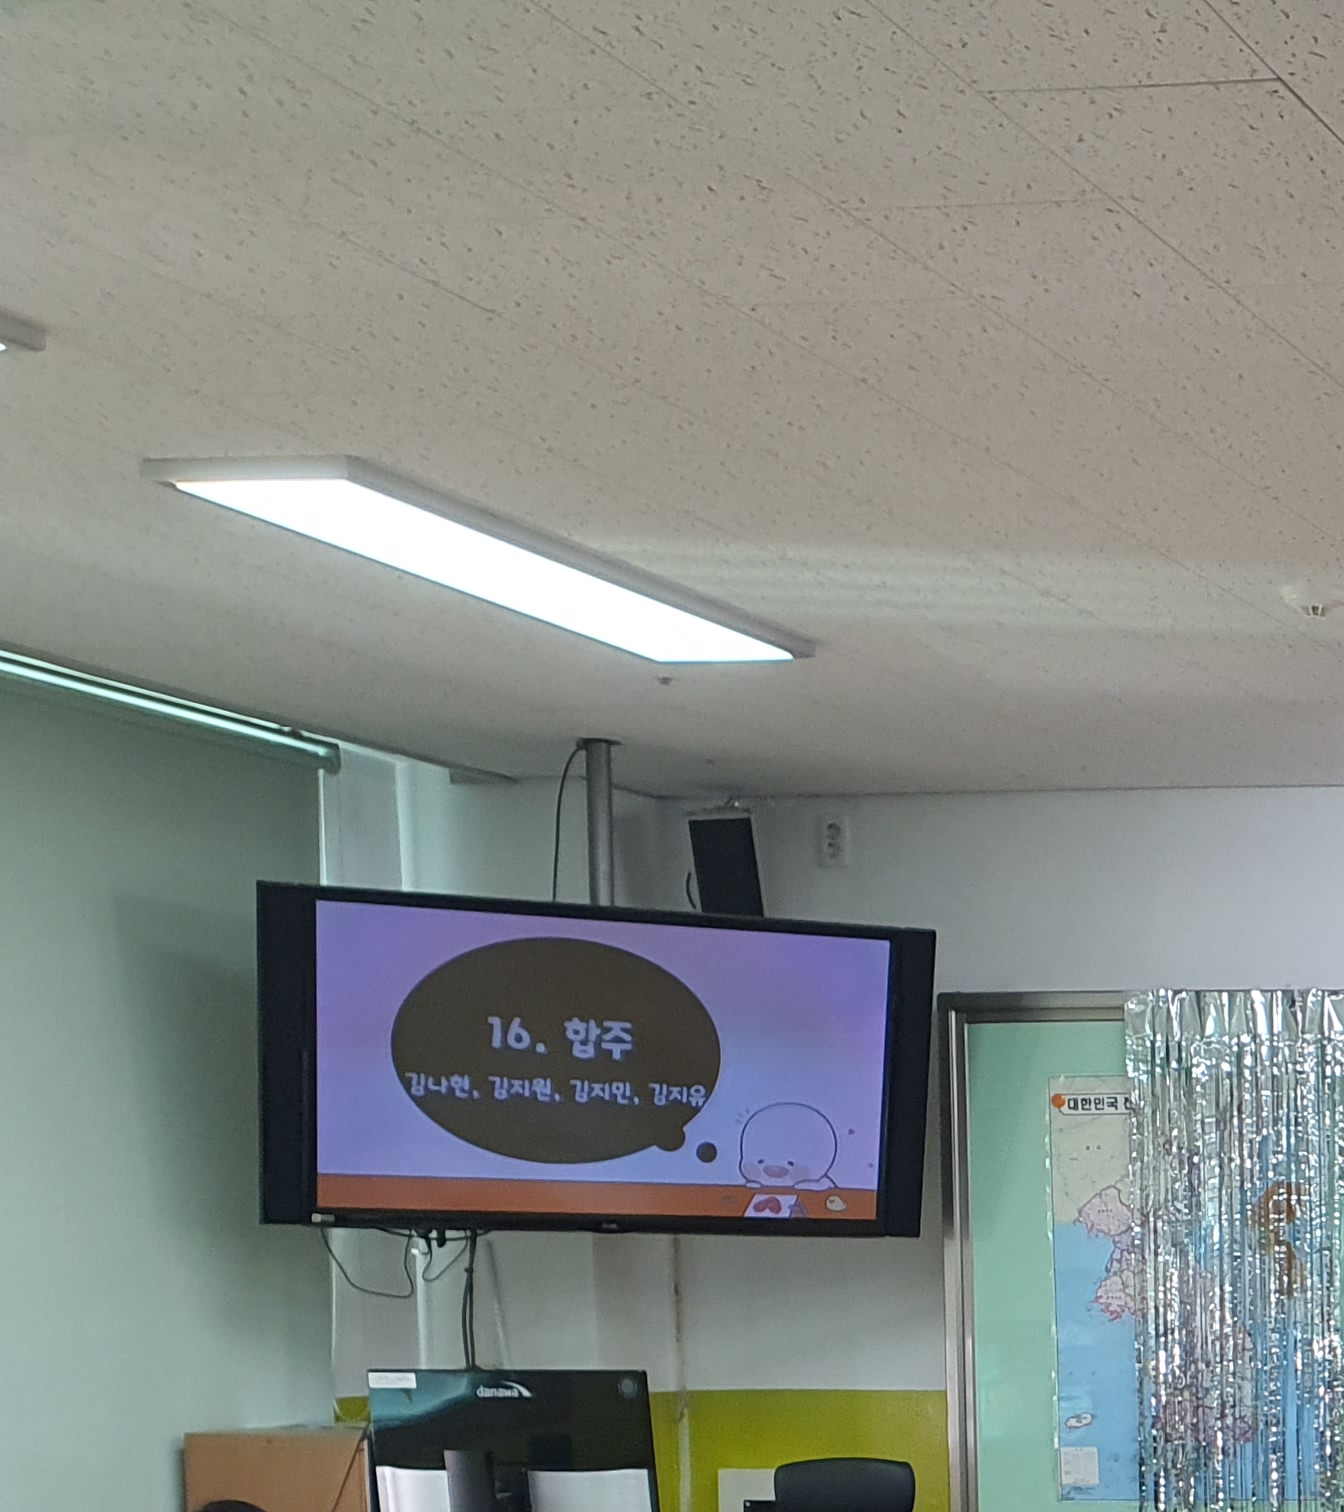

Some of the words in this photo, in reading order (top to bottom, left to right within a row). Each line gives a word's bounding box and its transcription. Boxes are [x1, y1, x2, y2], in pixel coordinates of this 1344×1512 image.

[487, 1016, 547, 1054] 16.
[564, 1017, 633, 1060] 합주
[488, 1075, 561, 1103] 김지원,
[570, 1079, 640, 1106] 김지민,
[649, 1083, 707, 1108] 김지유
[1067, 1096, 1119, 1111] 대한민국
[476, 1385, 519, 1398] danawa
